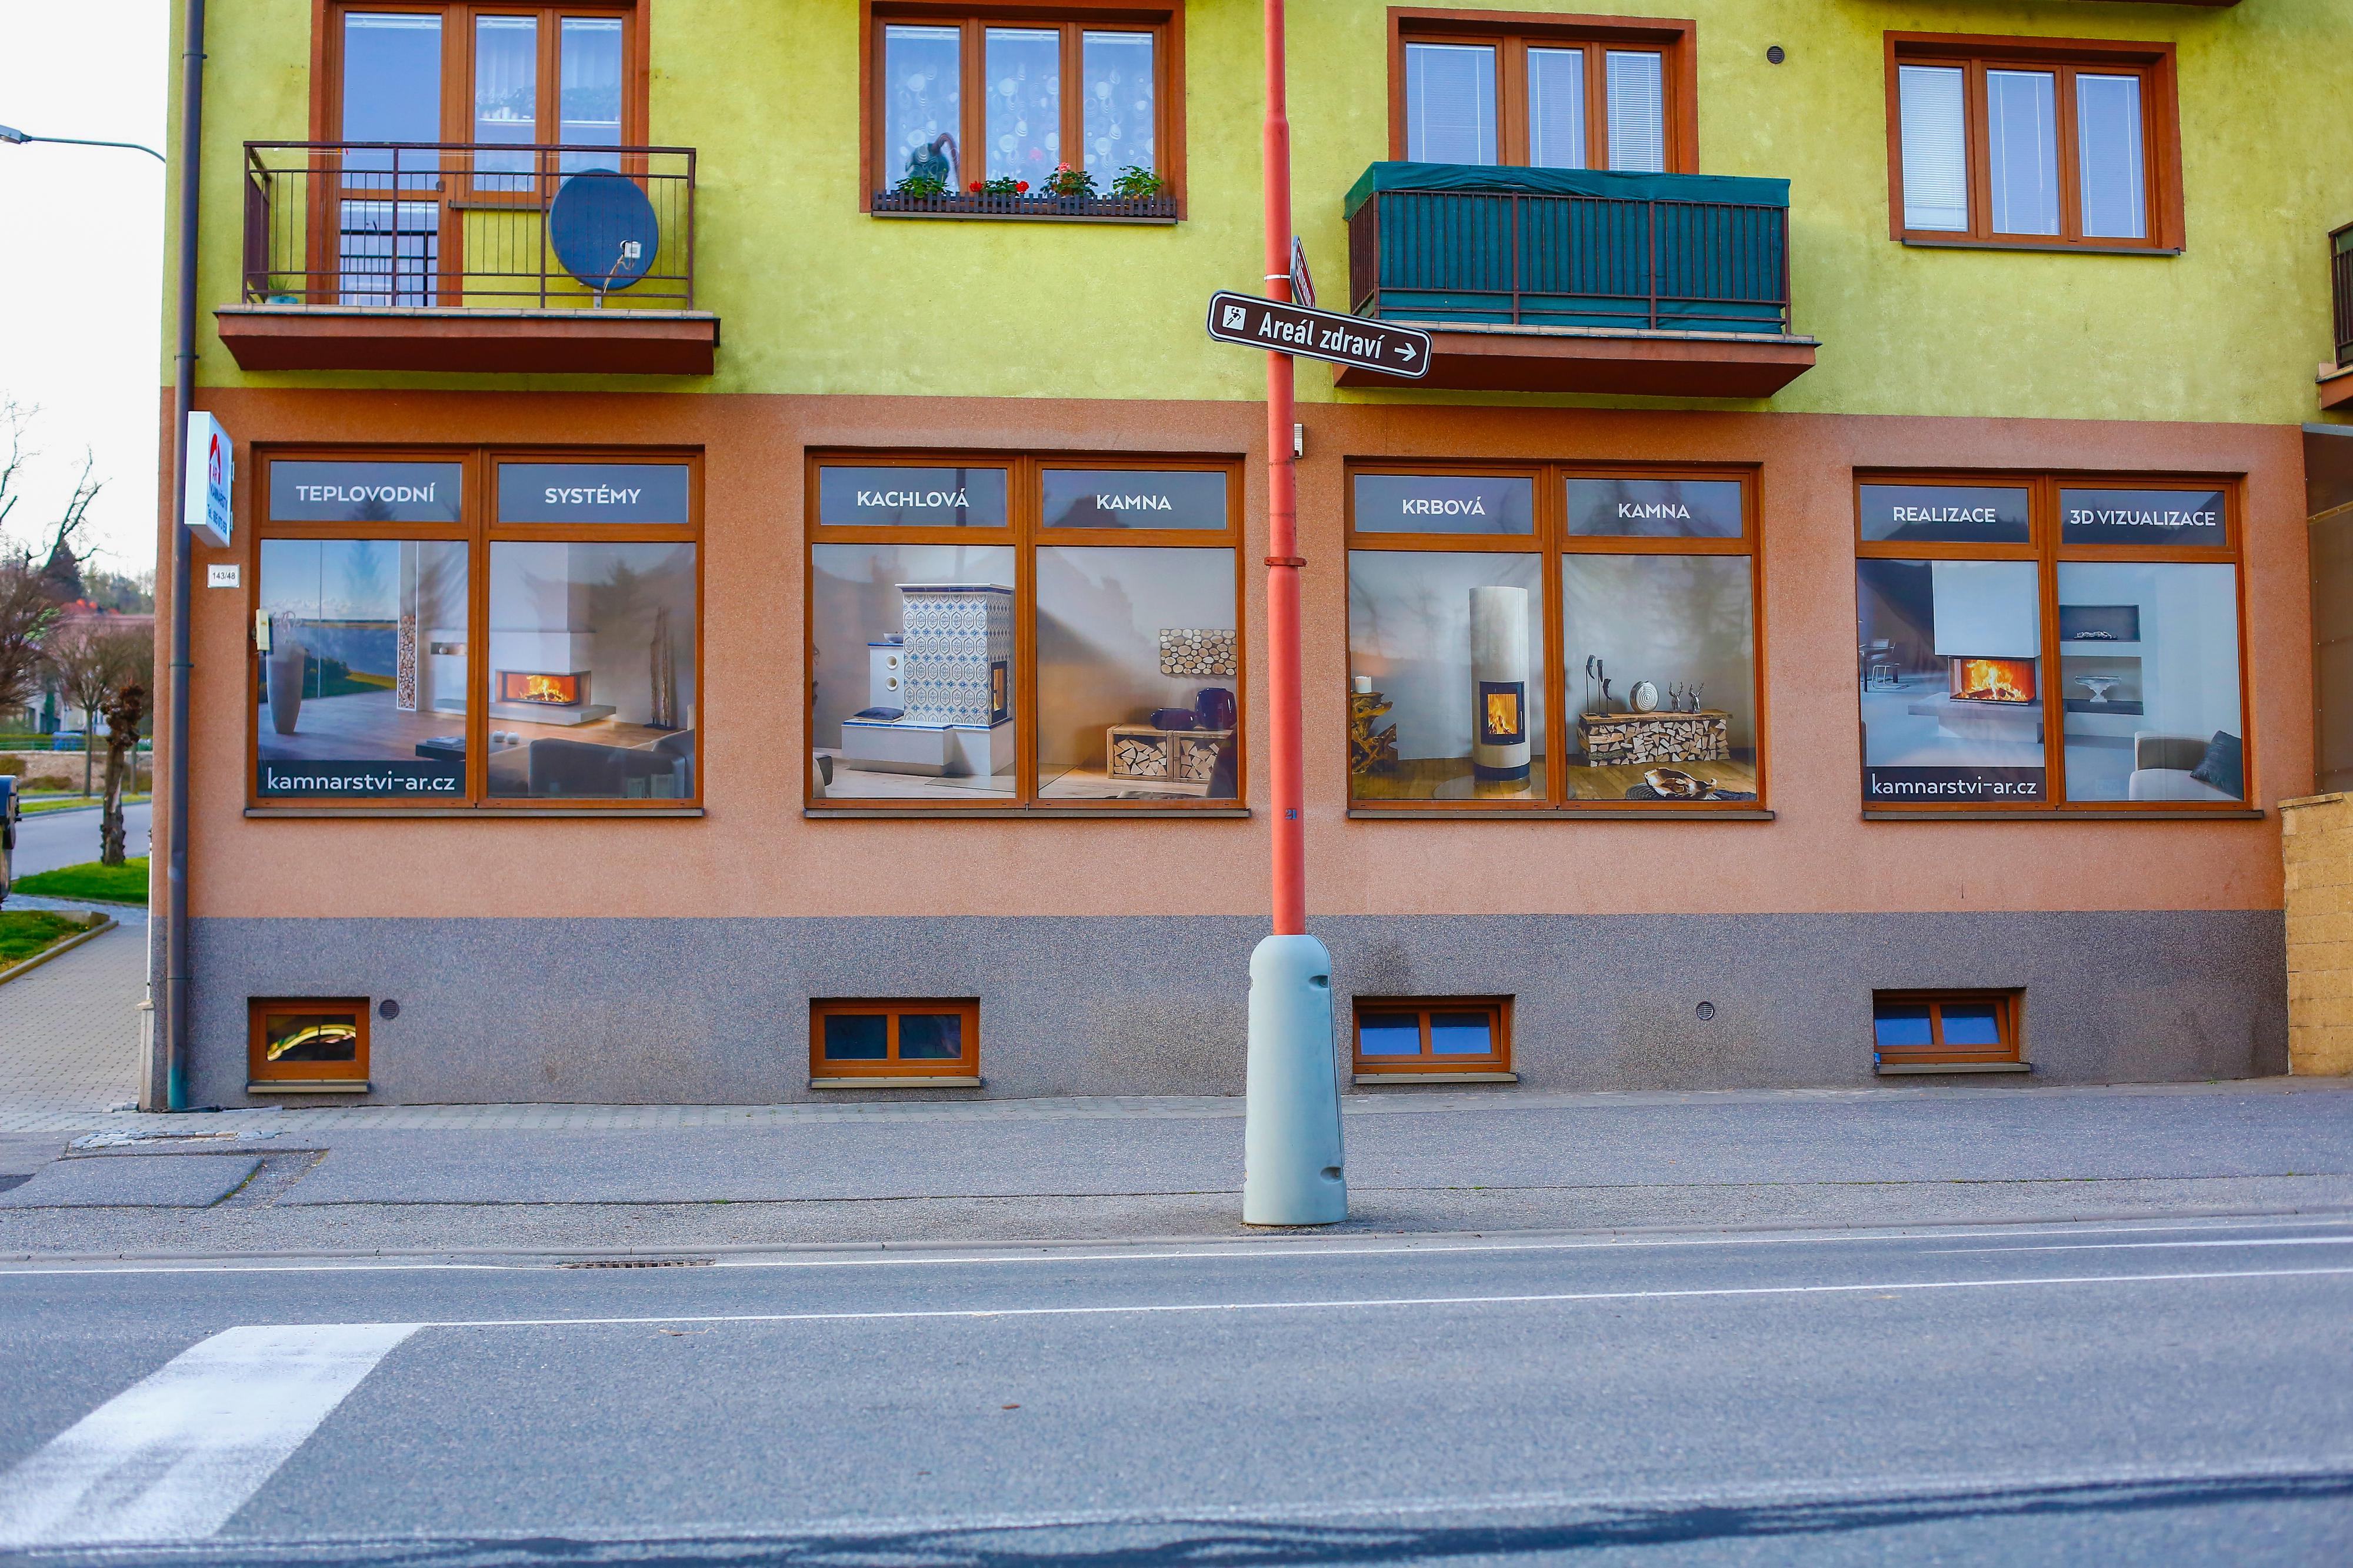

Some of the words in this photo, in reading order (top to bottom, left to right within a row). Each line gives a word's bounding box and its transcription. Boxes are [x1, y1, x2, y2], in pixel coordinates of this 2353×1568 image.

[1258, 311, 1315, 346] Areál
[1319, 326, 1385, 359] zdraví
[295, 482, 435, 502] TEPLOVODNÍ
[545, 484, 641, 505] SYSTÉMY
[856, 488, 970, 508] KACHLOVÁ
[1096, 493, 1172, 511] KAMNA
[1402, 496, 1485, 515] KRBOVÁ
[1618, 503, 1691, 519] KAMNA
[1893, 506, 1996, 523] REALIZACE
[2070, 509, 2094, 525] 3D
[2098, 510, 2216, 526] VIZUALIZACE
[212, 572, 235, 580] 143/48
[267, 767, 455, 790] kamnarstvi-ar.cz
[1872, 773, 2037, 795] kamnarstvi-ar.cz
